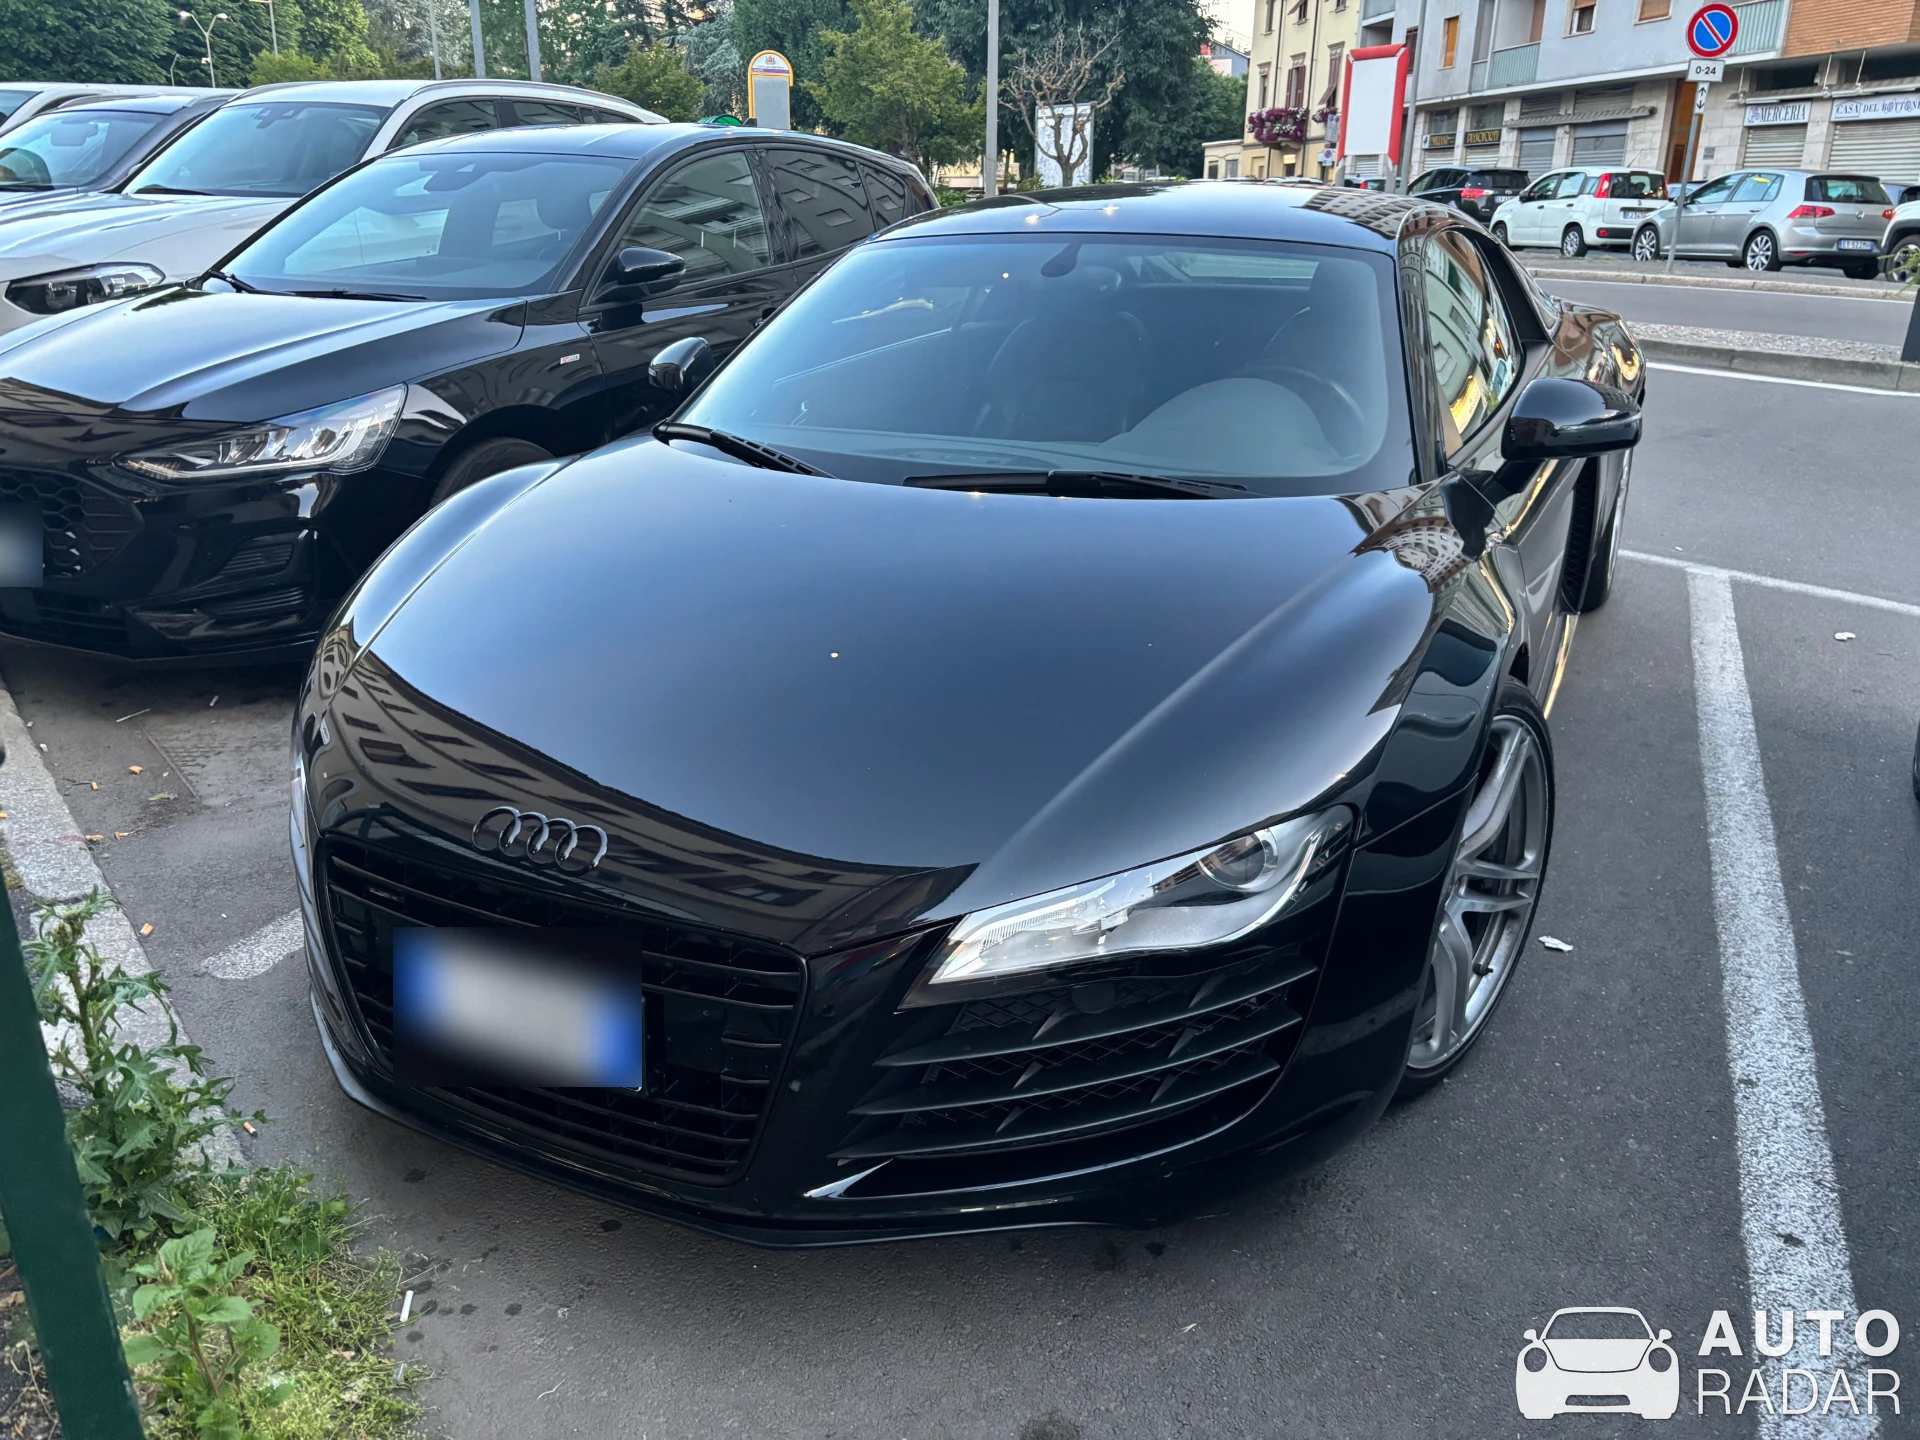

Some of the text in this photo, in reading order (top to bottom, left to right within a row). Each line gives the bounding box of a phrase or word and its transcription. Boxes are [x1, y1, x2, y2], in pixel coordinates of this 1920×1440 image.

[1695, 66, 1716, 75] 0-24
[1761, 104, 1806, 122] MERCERIA
[1836, 103, 1859, 115] CASA
[1863, 102, 1878, 113] DEL
